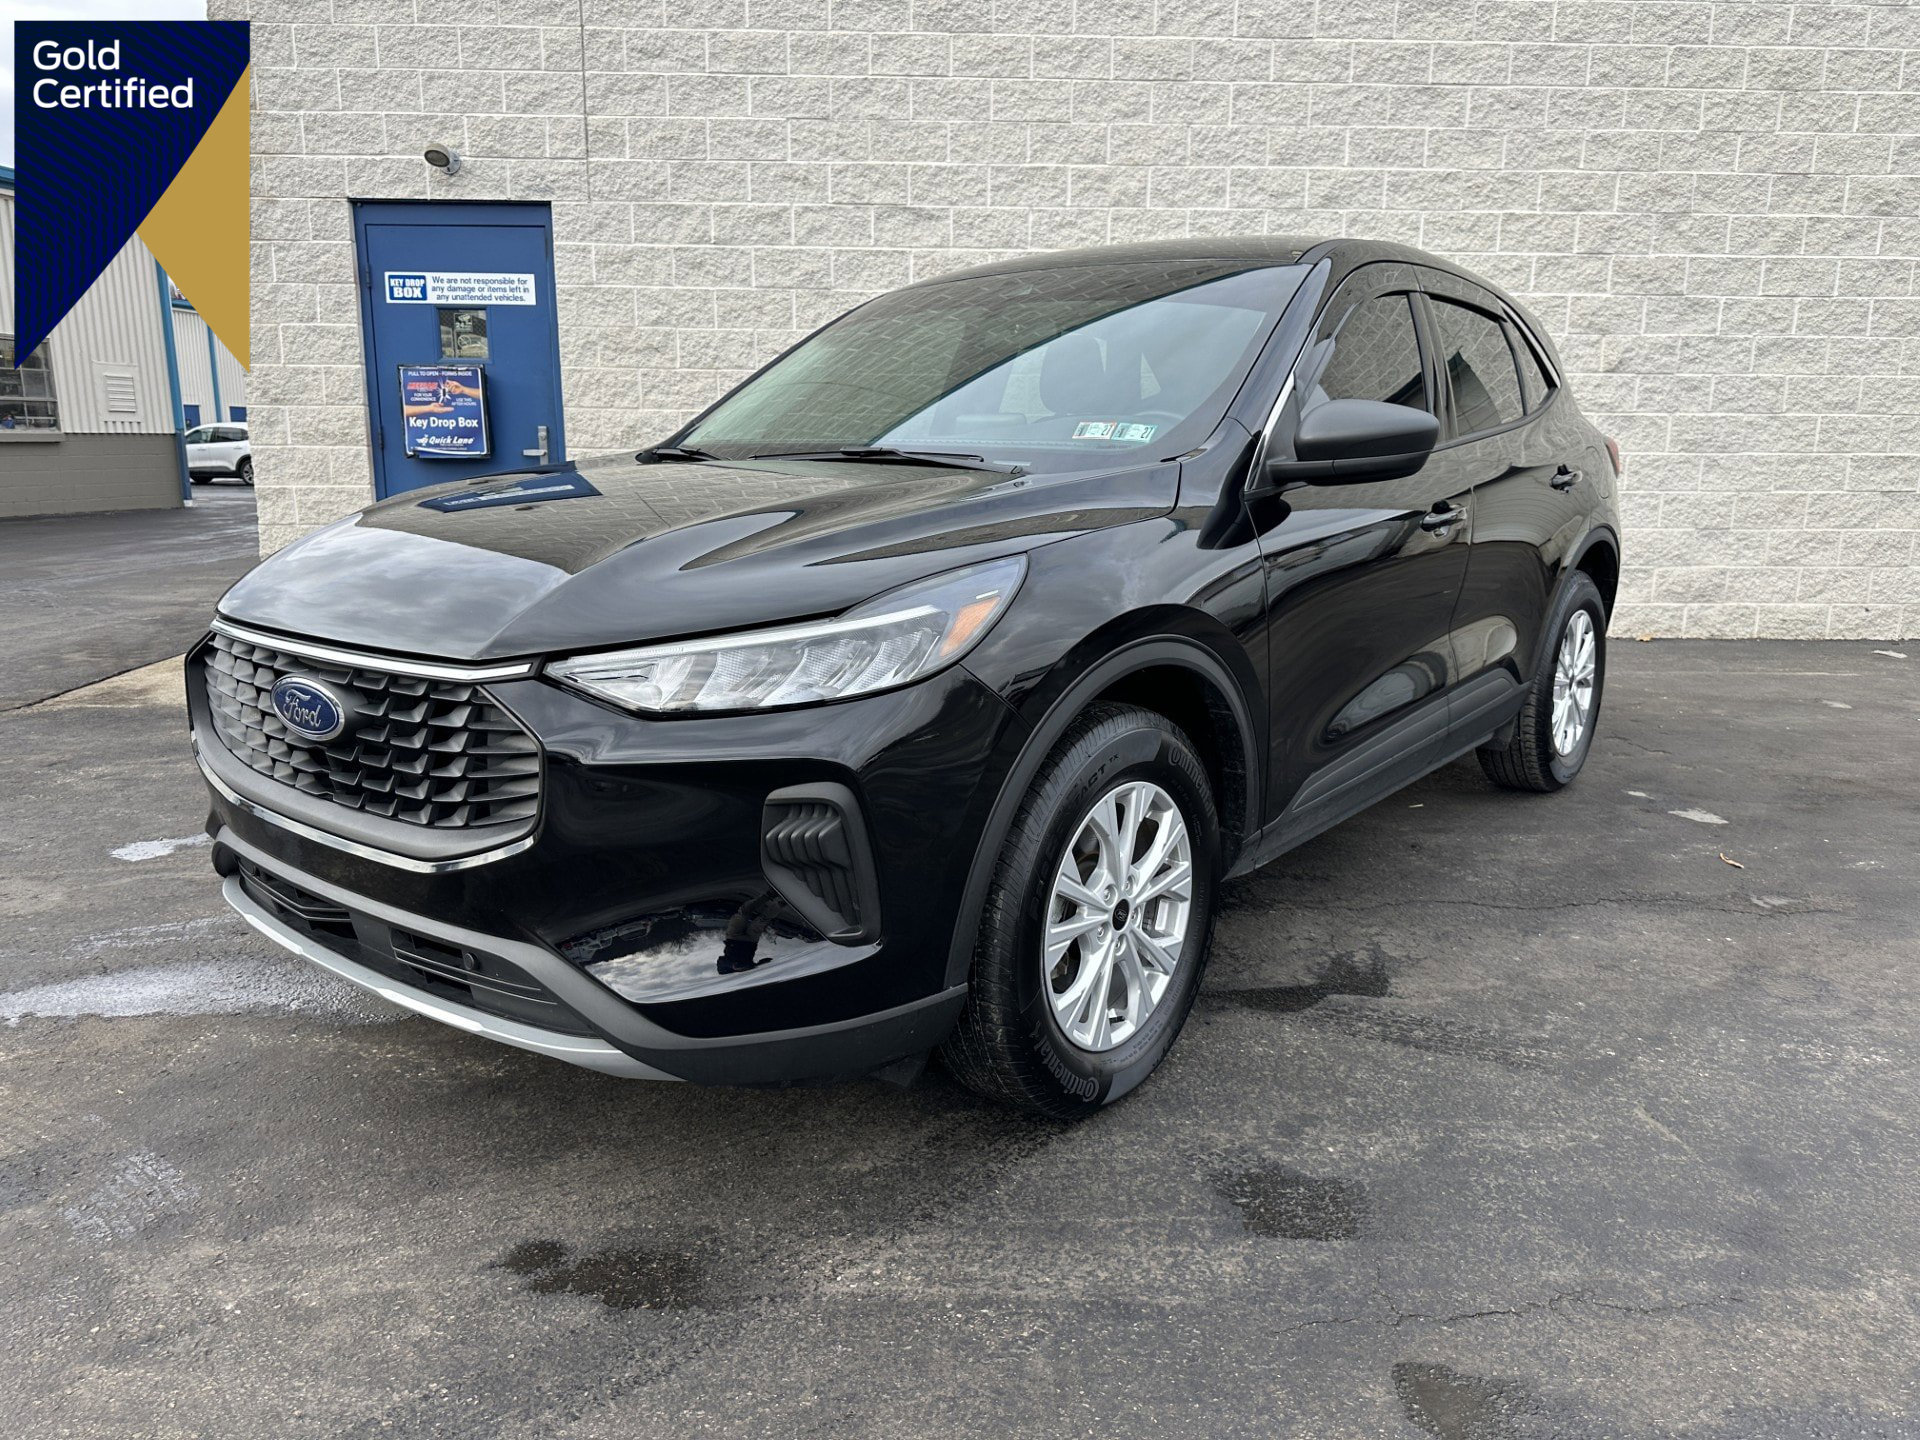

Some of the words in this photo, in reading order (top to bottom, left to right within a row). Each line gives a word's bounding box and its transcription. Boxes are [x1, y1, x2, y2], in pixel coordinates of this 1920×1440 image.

[390, 278, 404, 287] KEY
[405, 278, 425, 287] DROP
[432, 276, 444, 284] We
[473, 276, 516, 286] responsible
[517, 277, 528, 285] for
[393, 286, 423, 298] BOX
[446, 285, 476, 294] damage
[487, 285, 507, 293] items
[509, 285, 521, 293] left
[436, 294, 449, 302] any
[451, 293, 493, 301] unattended
[409, 417, 428, 430] Key
[429, 417, 457, 430] Drop
[458, 417, 479, 428] Box
[429, 435, 452, 445] Quick
[453, 436, 474, 444] Lane
[283, 688, 322, 728] Ford
[1033, 1034, 1100, 1102] Continental
